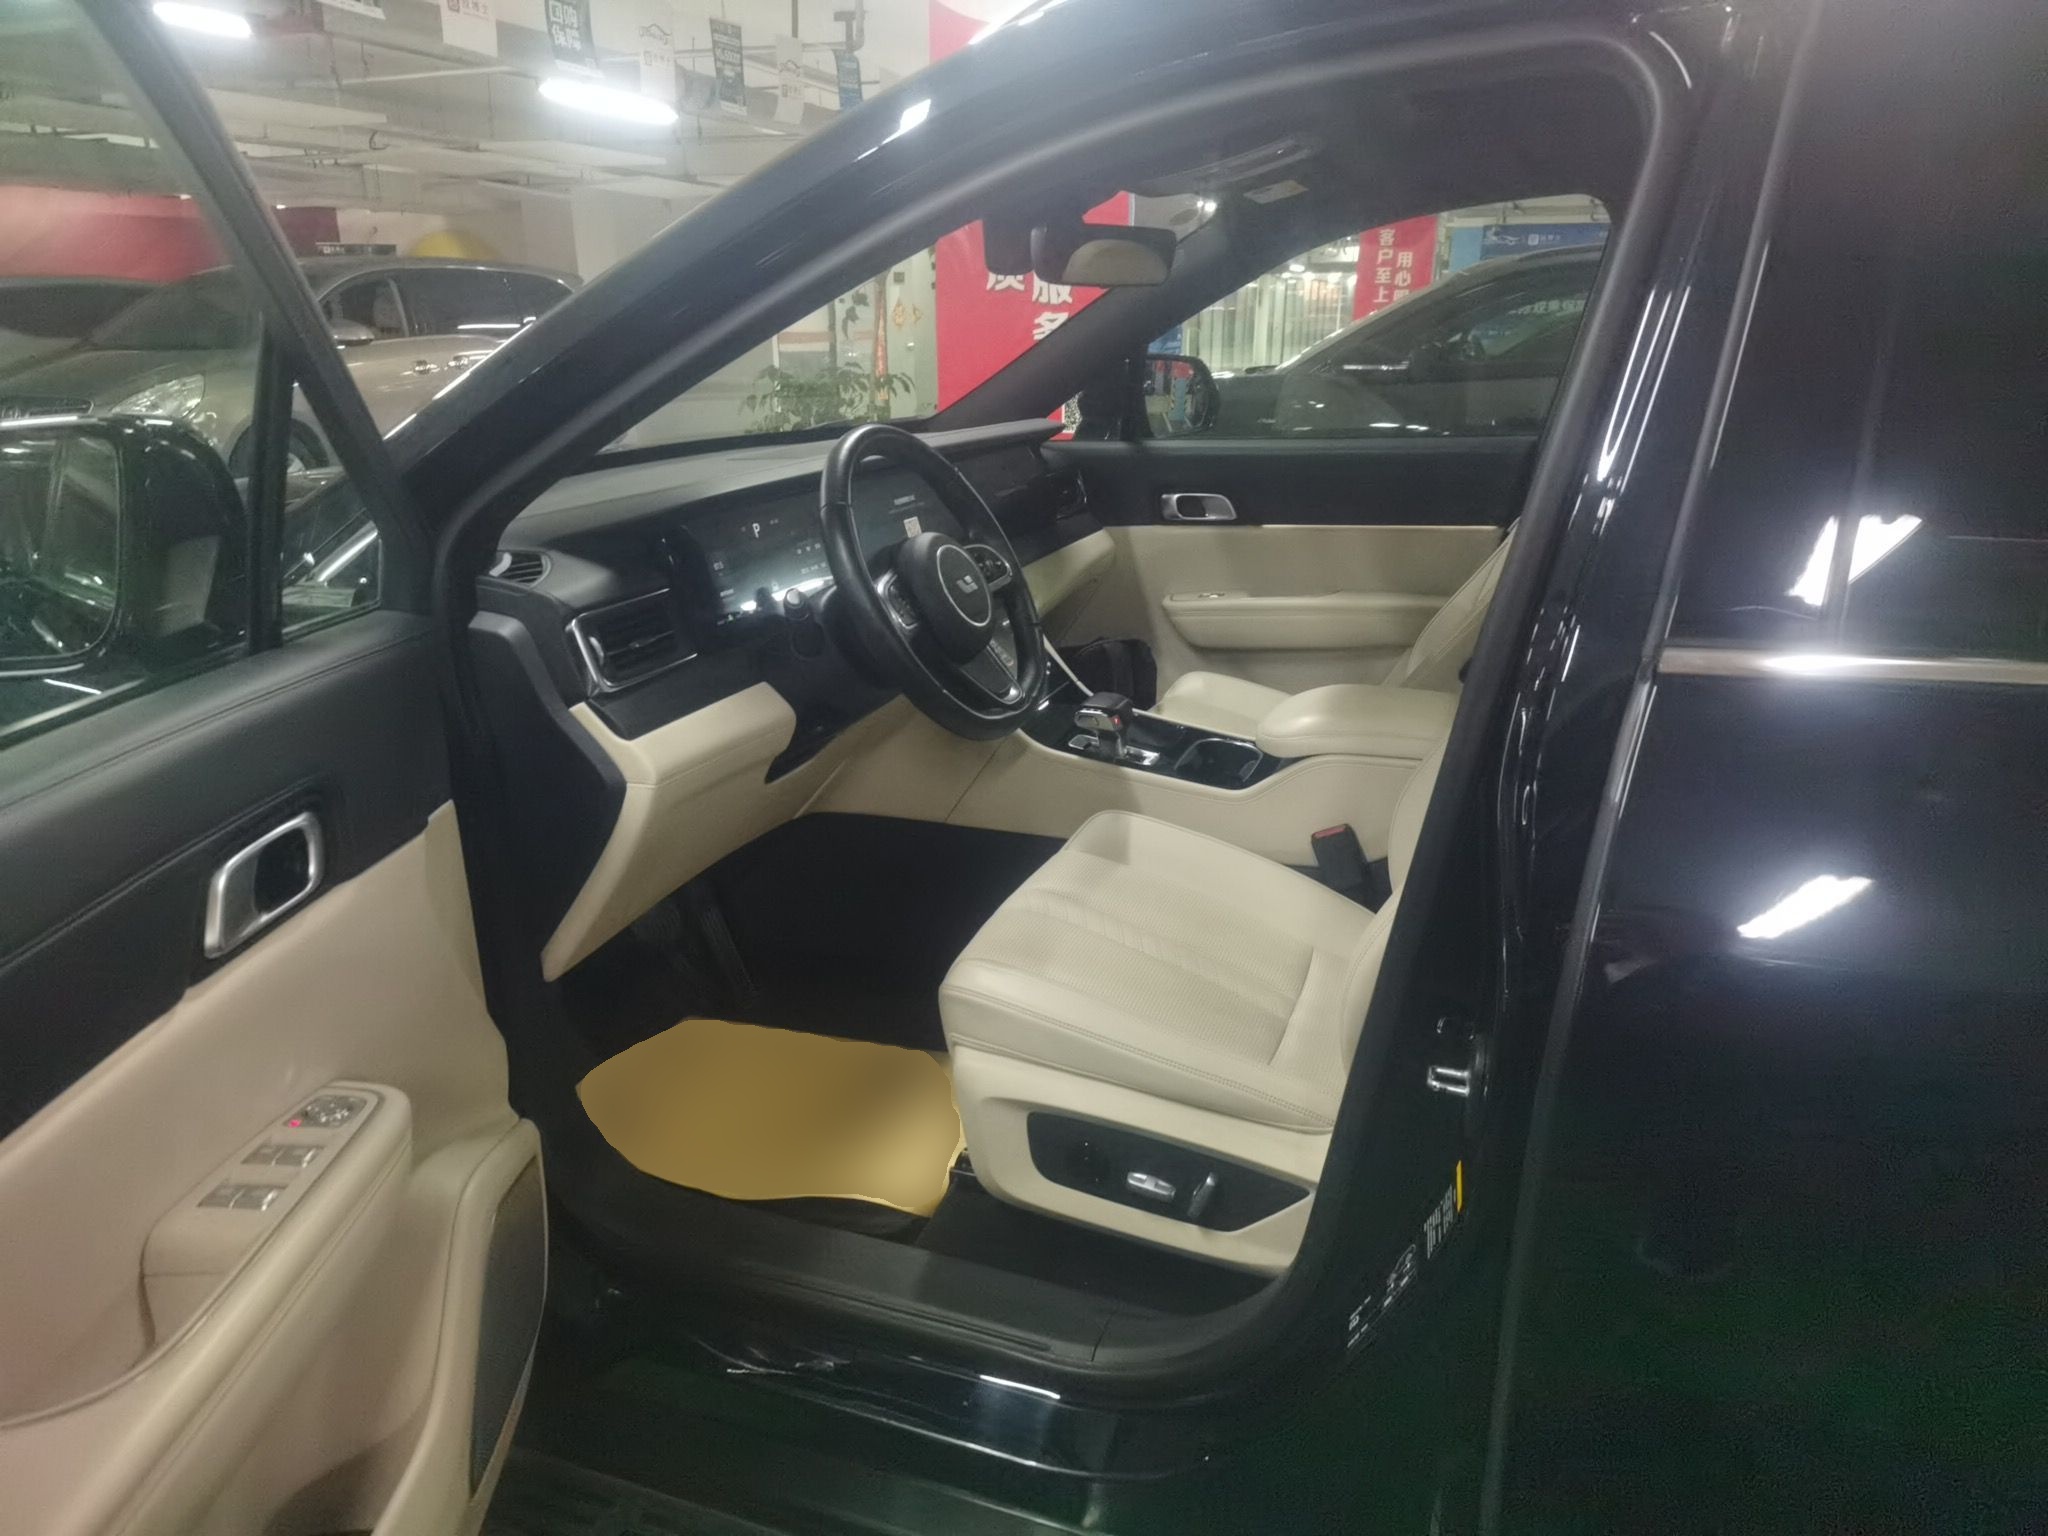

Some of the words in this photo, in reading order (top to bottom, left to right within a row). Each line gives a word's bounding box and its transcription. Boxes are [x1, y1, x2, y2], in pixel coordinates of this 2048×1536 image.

[1373, 228, 1396, 303] 客户至上
[752, 522, 761, 539] P
